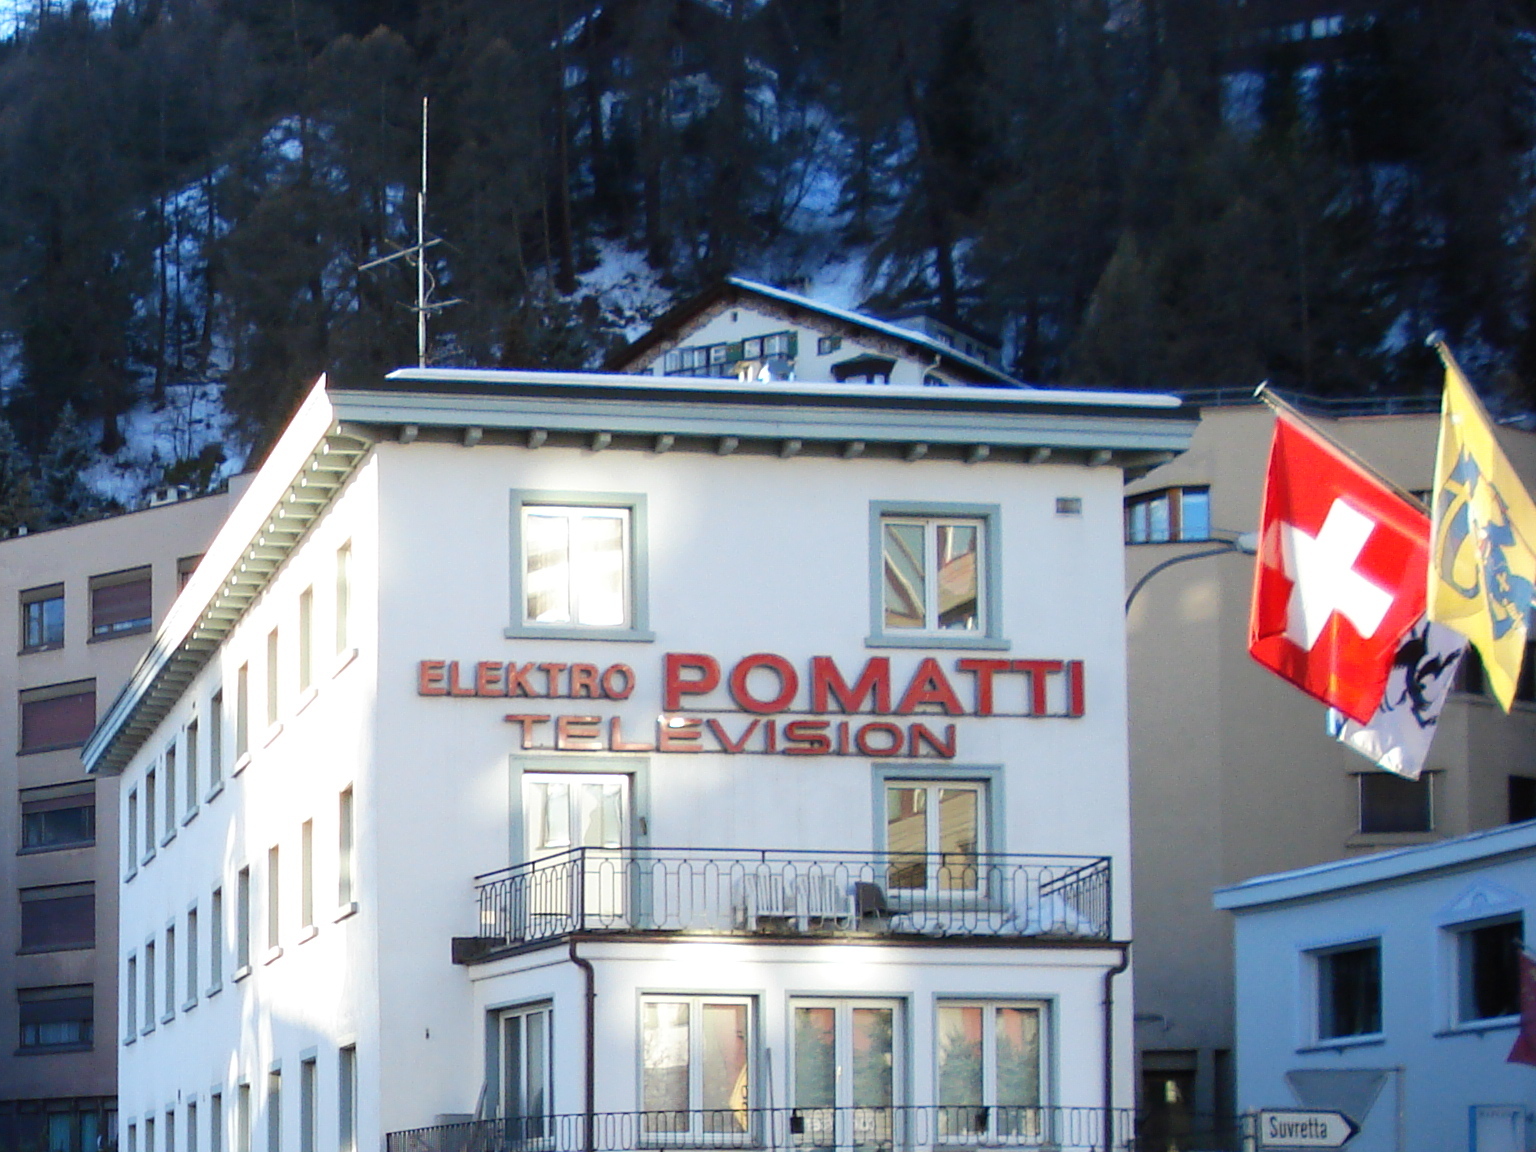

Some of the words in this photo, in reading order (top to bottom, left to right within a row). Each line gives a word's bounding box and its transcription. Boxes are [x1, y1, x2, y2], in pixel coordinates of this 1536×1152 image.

[416, 659, 636, 700] ELEKTRO
[663, 652, 1086, 718] POMATTI
[504, 713, 957, 759] TELEVISION
[1269, 1116, 1328, 1138] Suvretta
